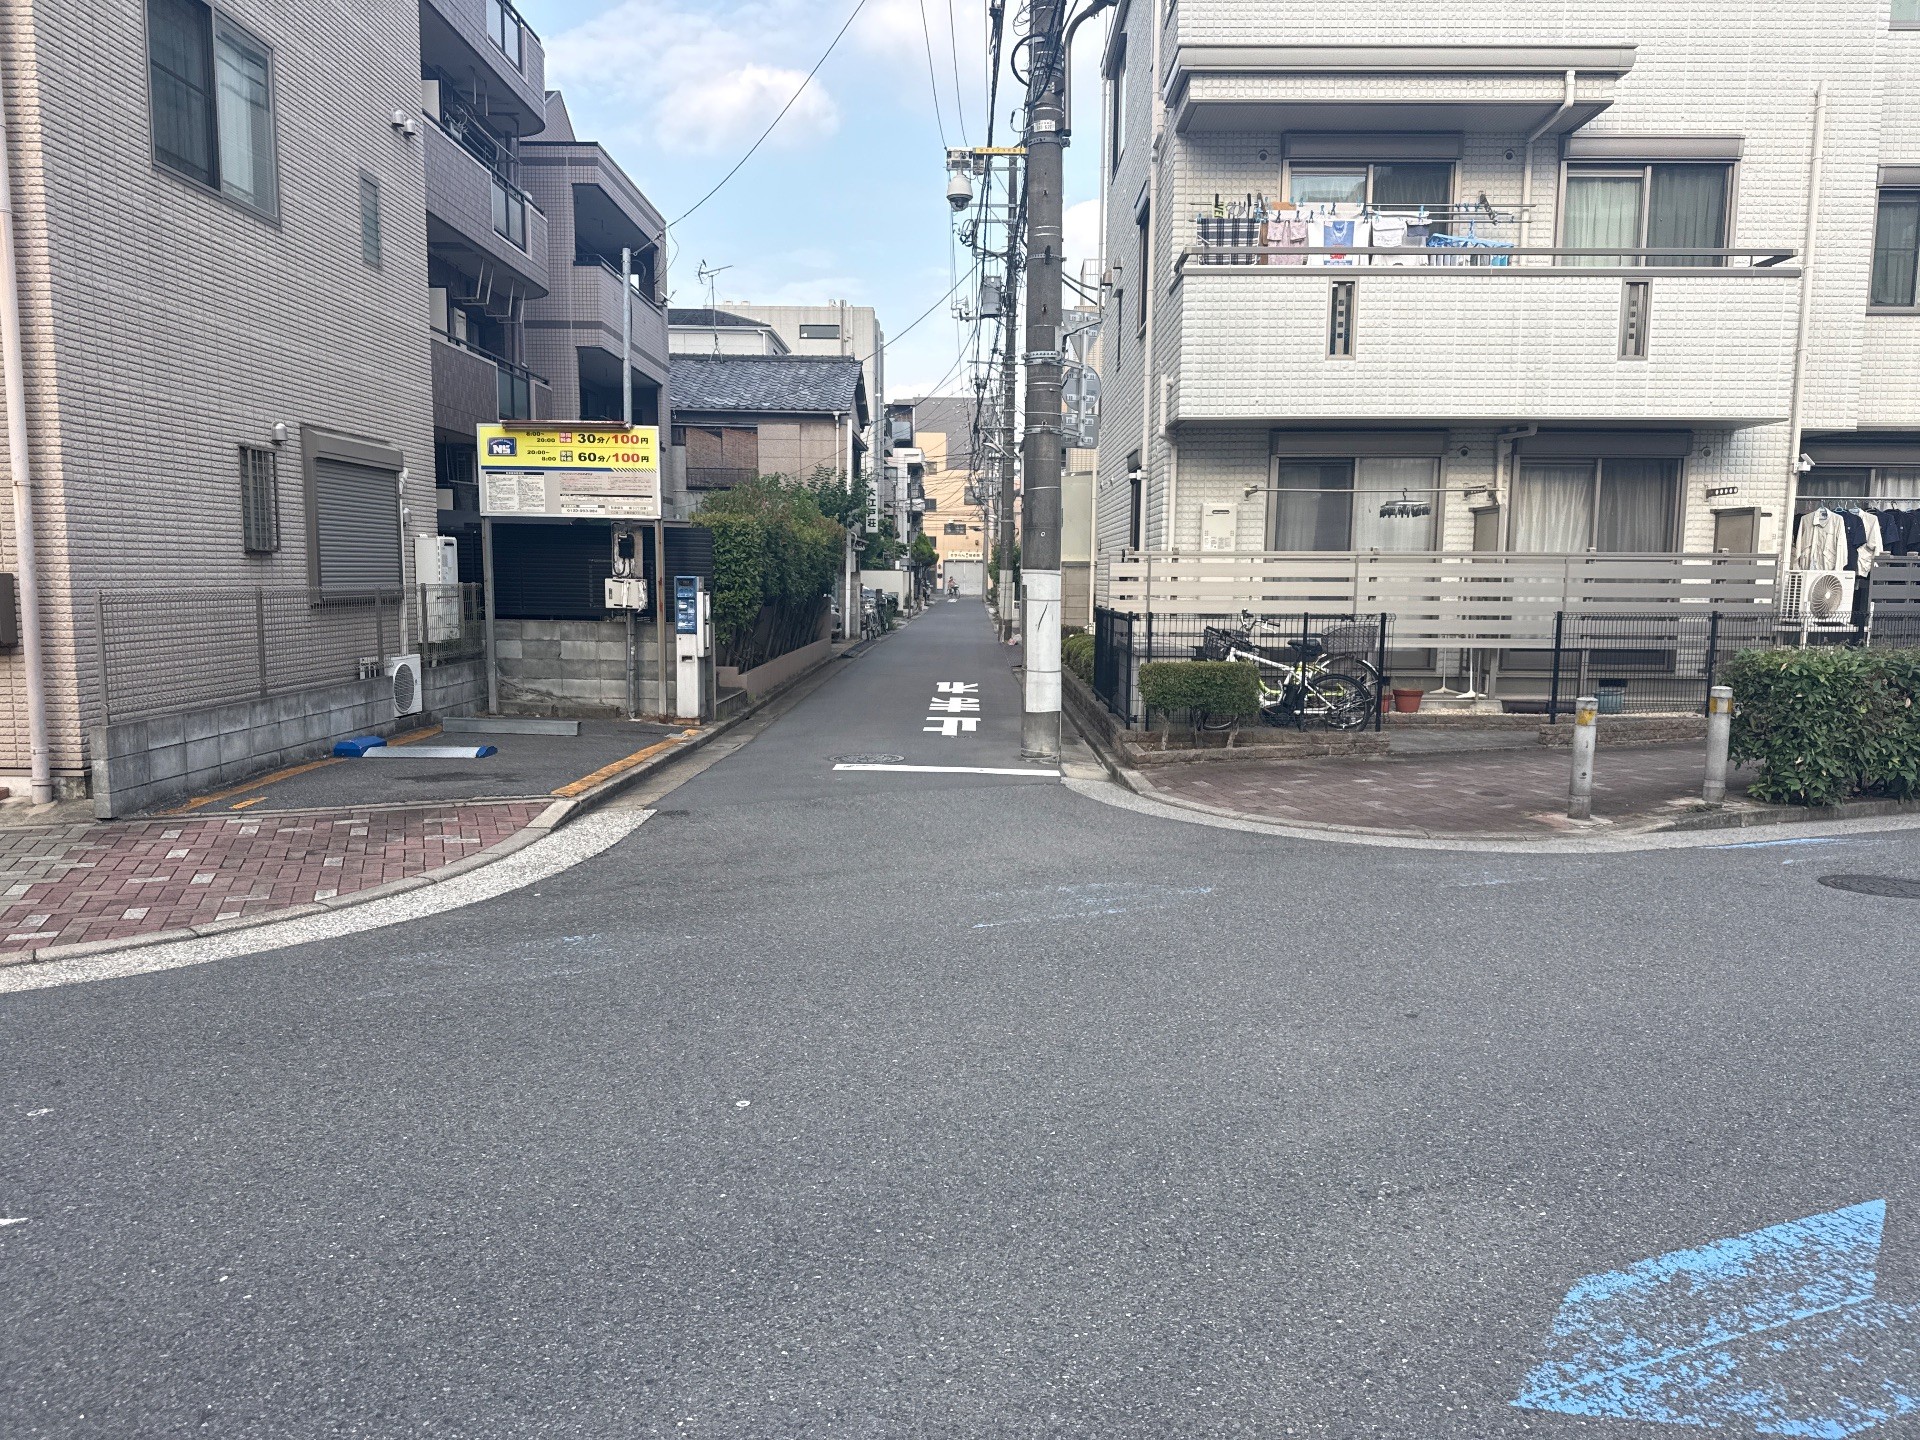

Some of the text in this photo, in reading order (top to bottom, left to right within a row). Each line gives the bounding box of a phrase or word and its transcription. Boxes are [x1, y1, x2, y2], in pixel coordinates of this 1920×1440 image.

[577, 433, 649, 444] 30分/100円
[578, 452, 649, 463] 60分/100円
[866, 487, 877, 528] 大江戸荘
[923, 681, 981, 736] 止まれ
